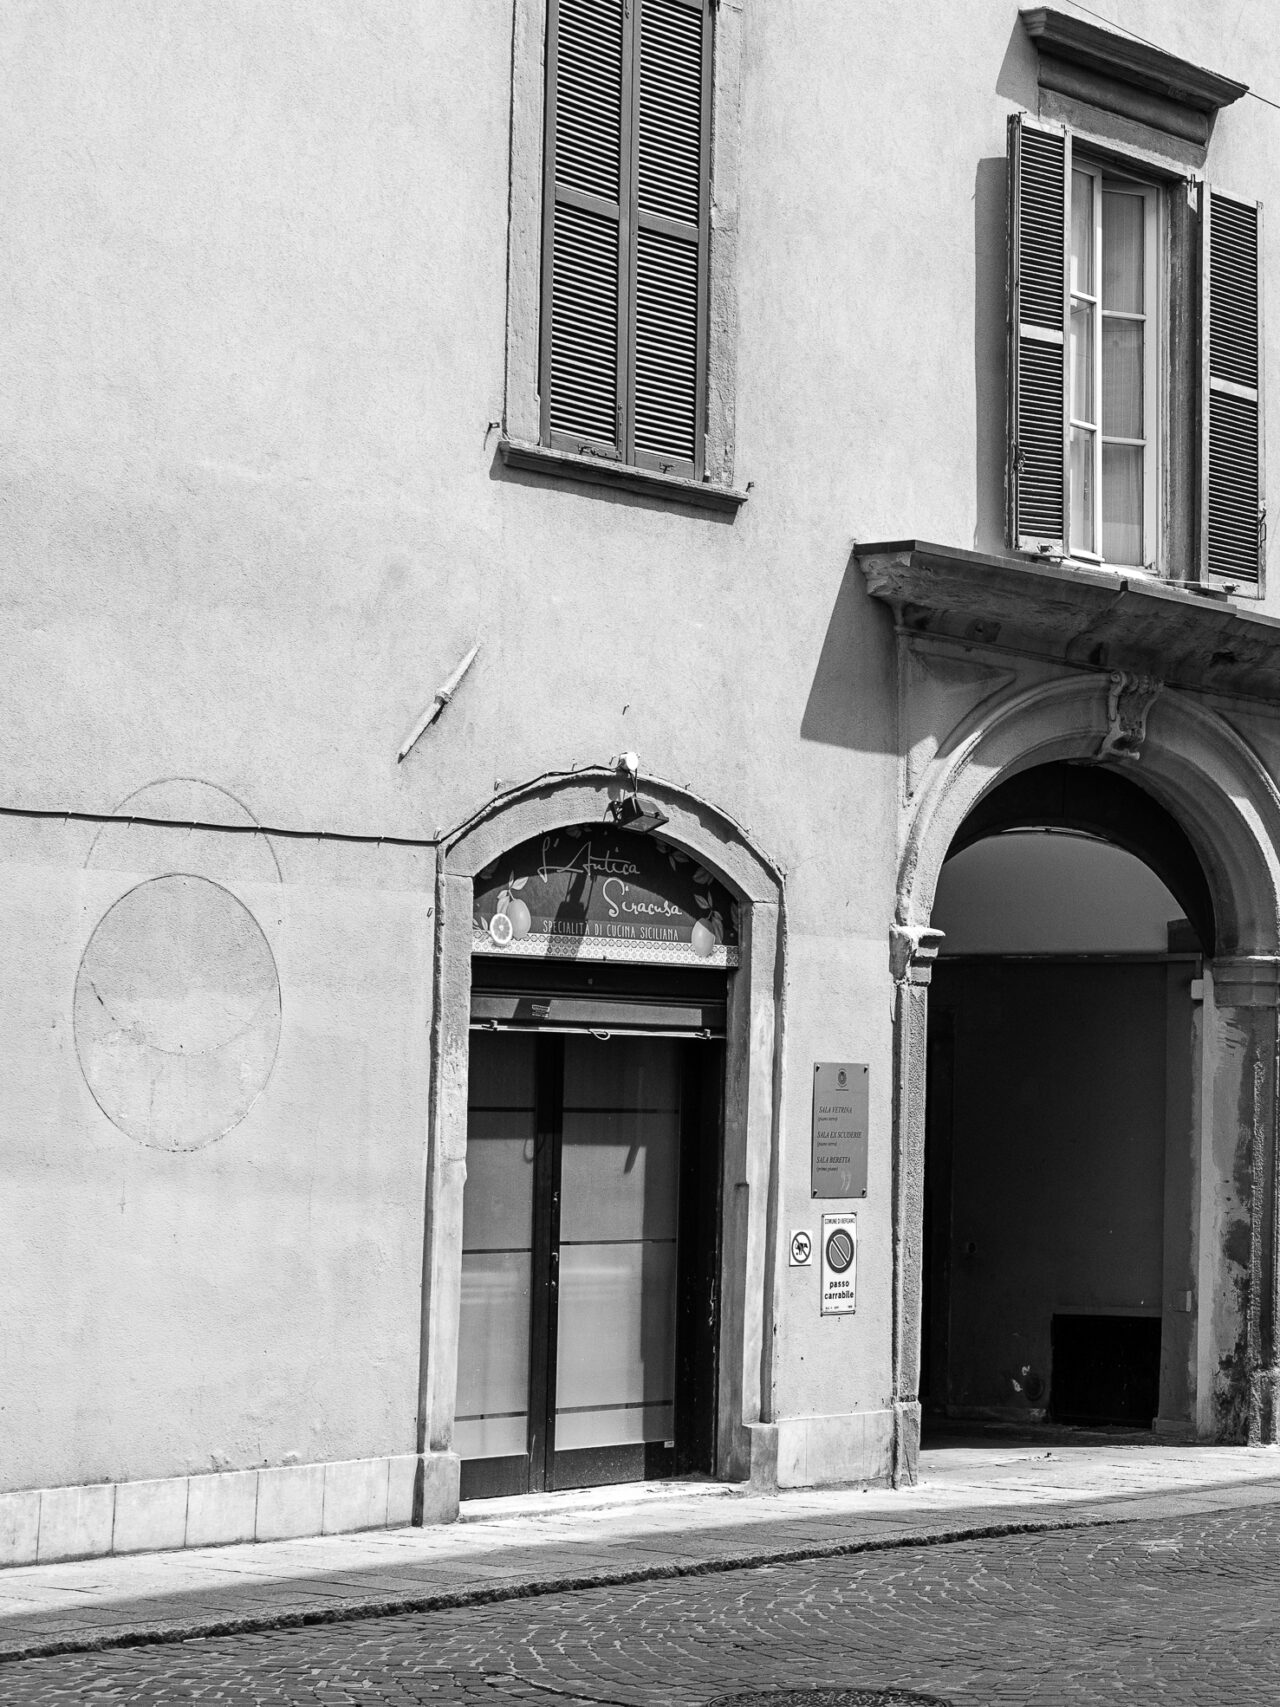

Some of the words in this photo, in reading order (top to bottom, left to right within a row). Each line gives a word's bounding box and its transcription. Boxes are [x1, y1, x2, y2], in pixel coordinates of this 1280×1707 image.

[602, 876, 683, 918] Siracusa
[543, 919, 590, 936] SPECIALITÀ
[594, 926, 602, 935] DI
[606, 925, 636, 938] CUCINA
[640, 927, 679, 941] SICILIANA
[829, 1280, 850, 1289] passo
[824, 1290, 854, 1300] carrabile
